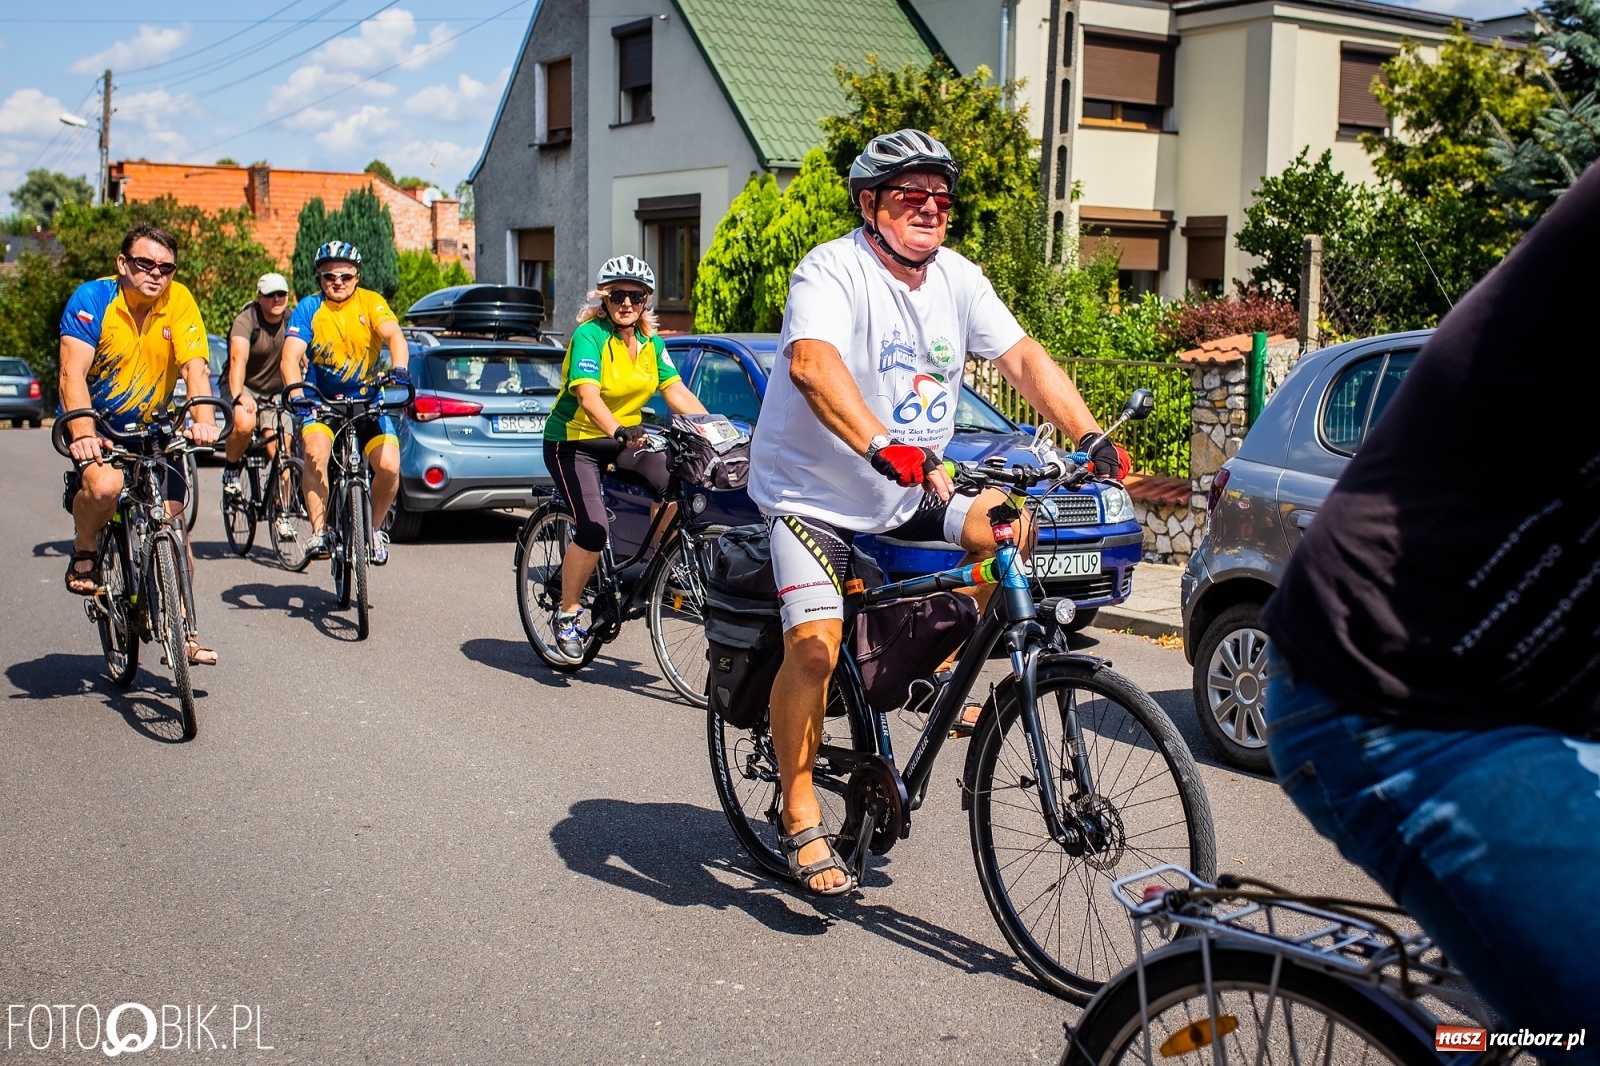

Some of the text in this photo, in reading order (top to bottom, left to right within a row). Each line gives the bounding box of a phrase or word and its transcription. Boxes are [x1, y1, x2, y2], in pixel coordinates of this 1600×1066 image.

[893, 390, 948, 425] 66
[501, 416, 526, 429] SRC
[529, 416, 548, 429] 5X
[1024, 554, 1099, 576] SRC 2TU9
